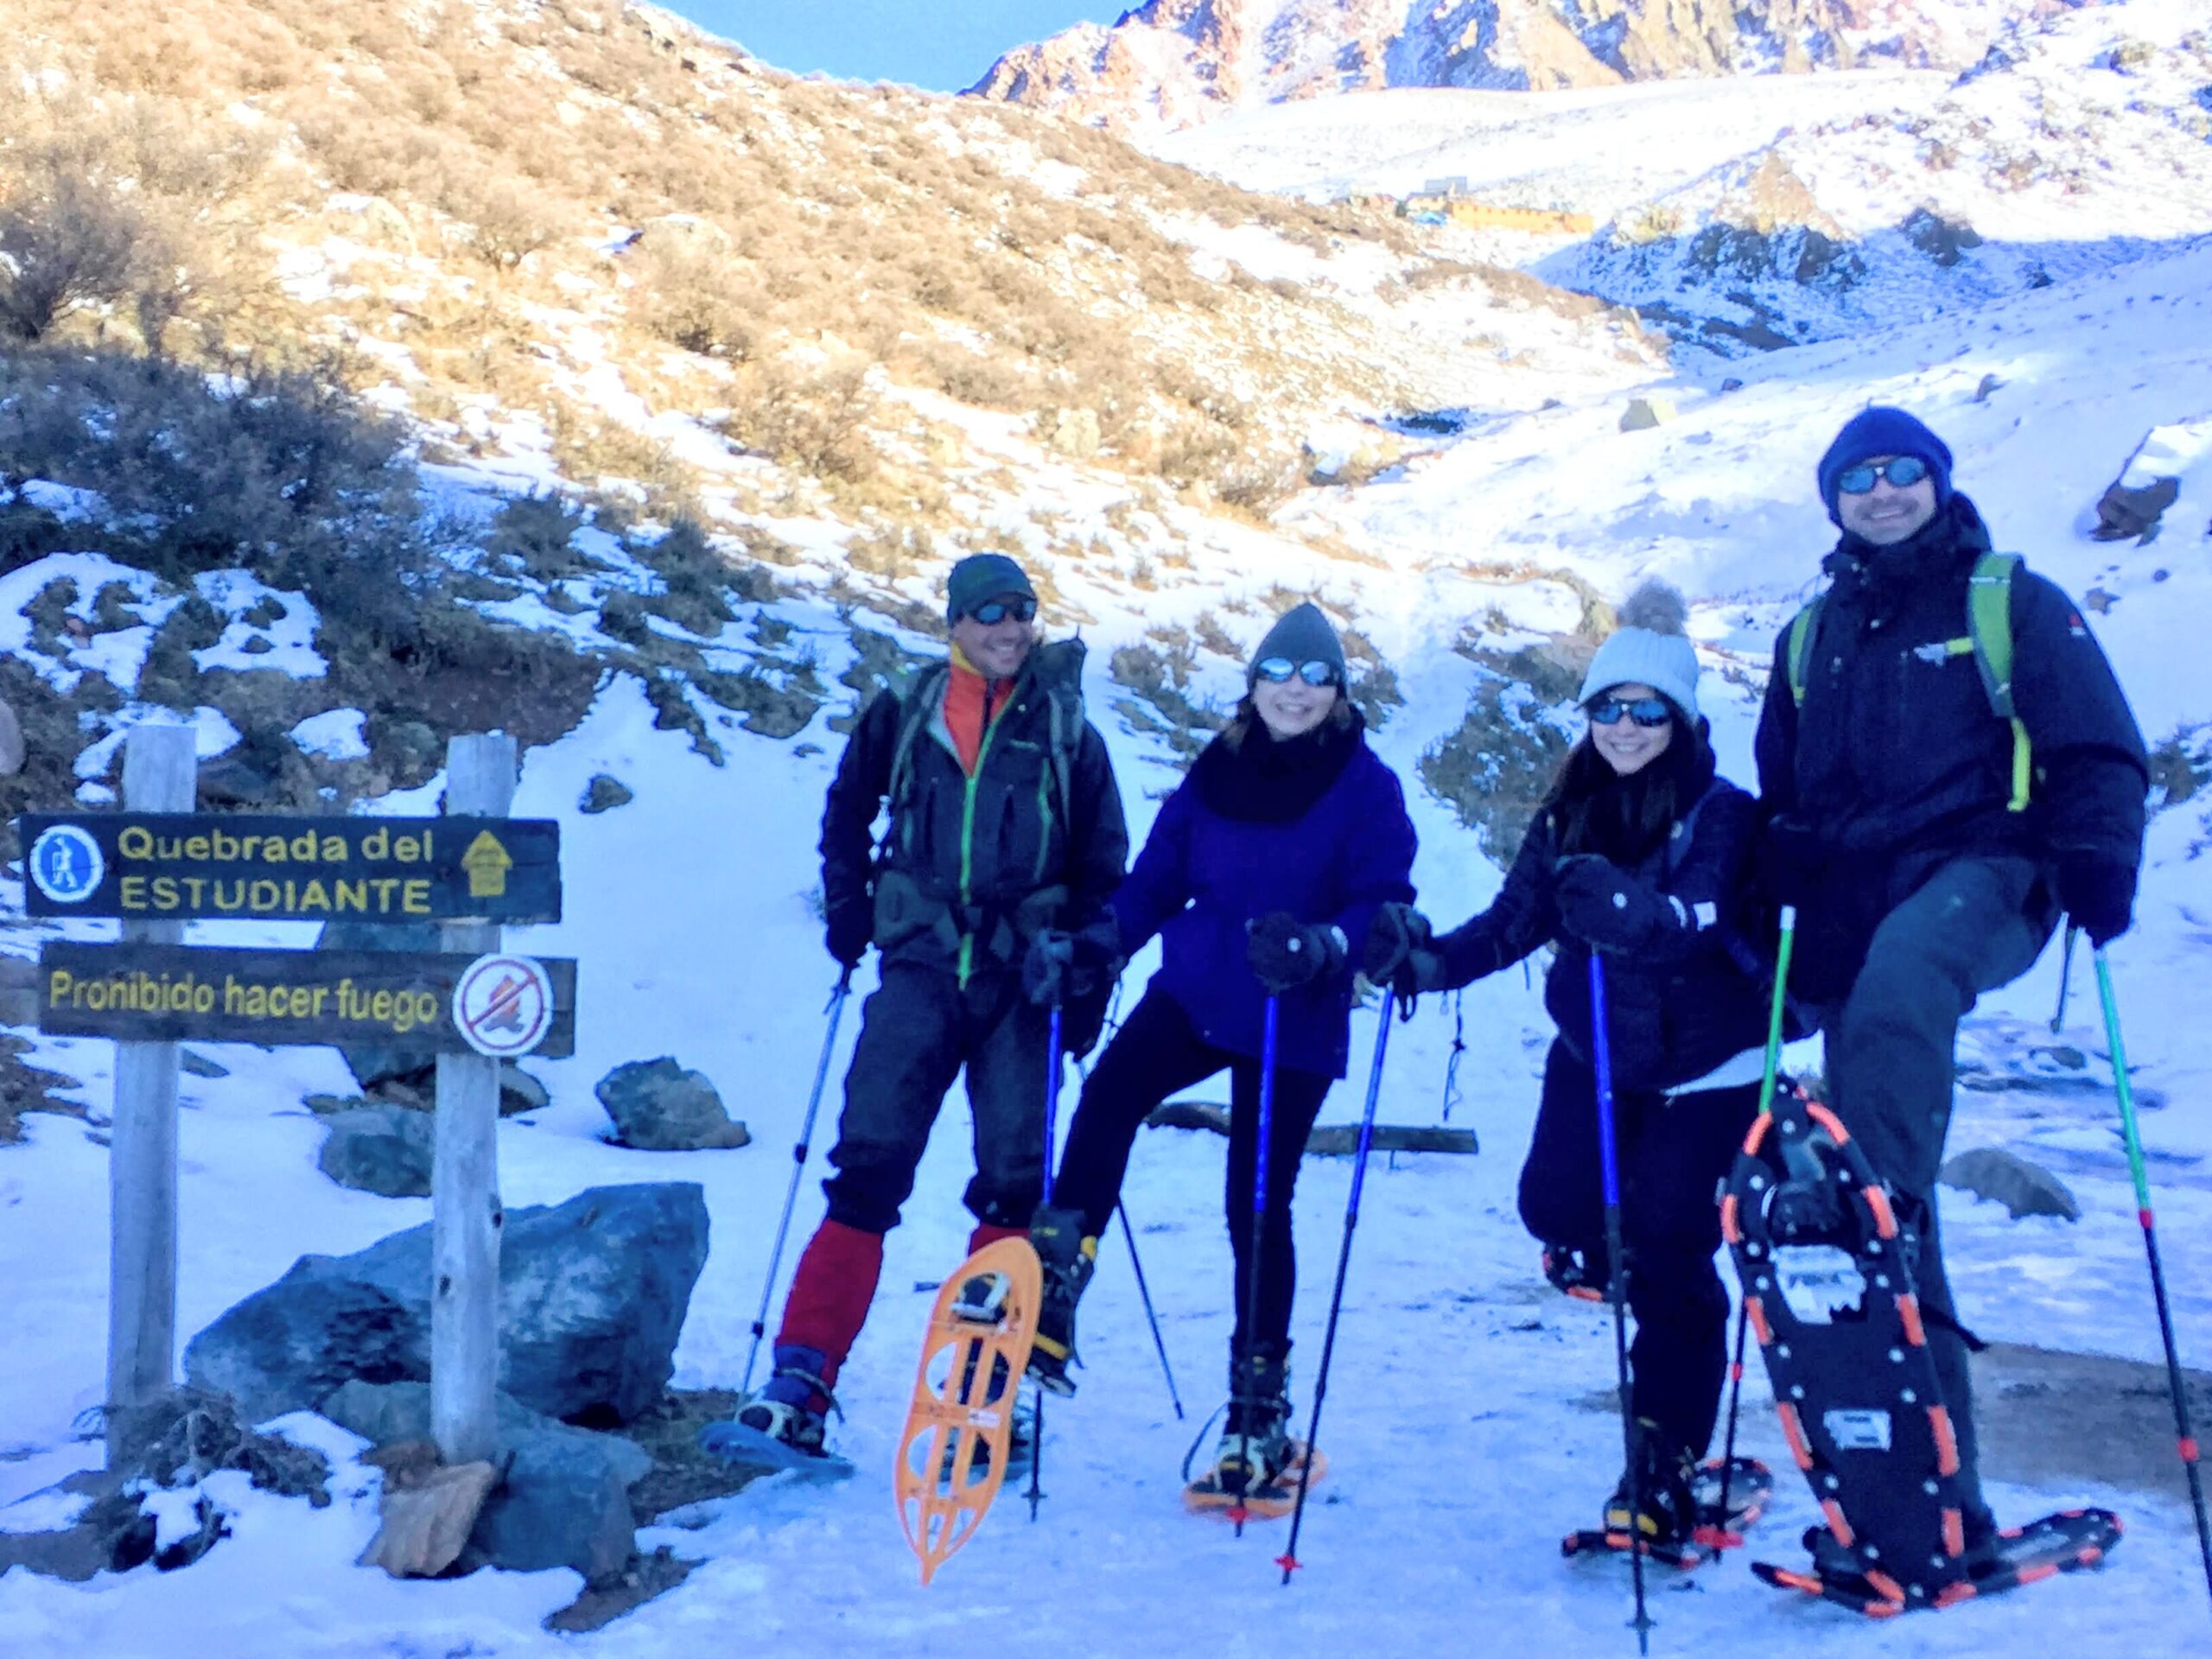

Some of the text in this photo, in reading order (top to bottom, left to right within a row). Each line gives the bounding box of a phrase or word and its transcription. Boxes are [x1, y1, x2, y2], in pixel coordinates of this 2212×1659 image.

[118, 826, 433, 862] Quebrada del
[120, 876, 431, 914] ESTUDIANTE
[49, 969, 439, 1033] Prohibido hacer fuego
